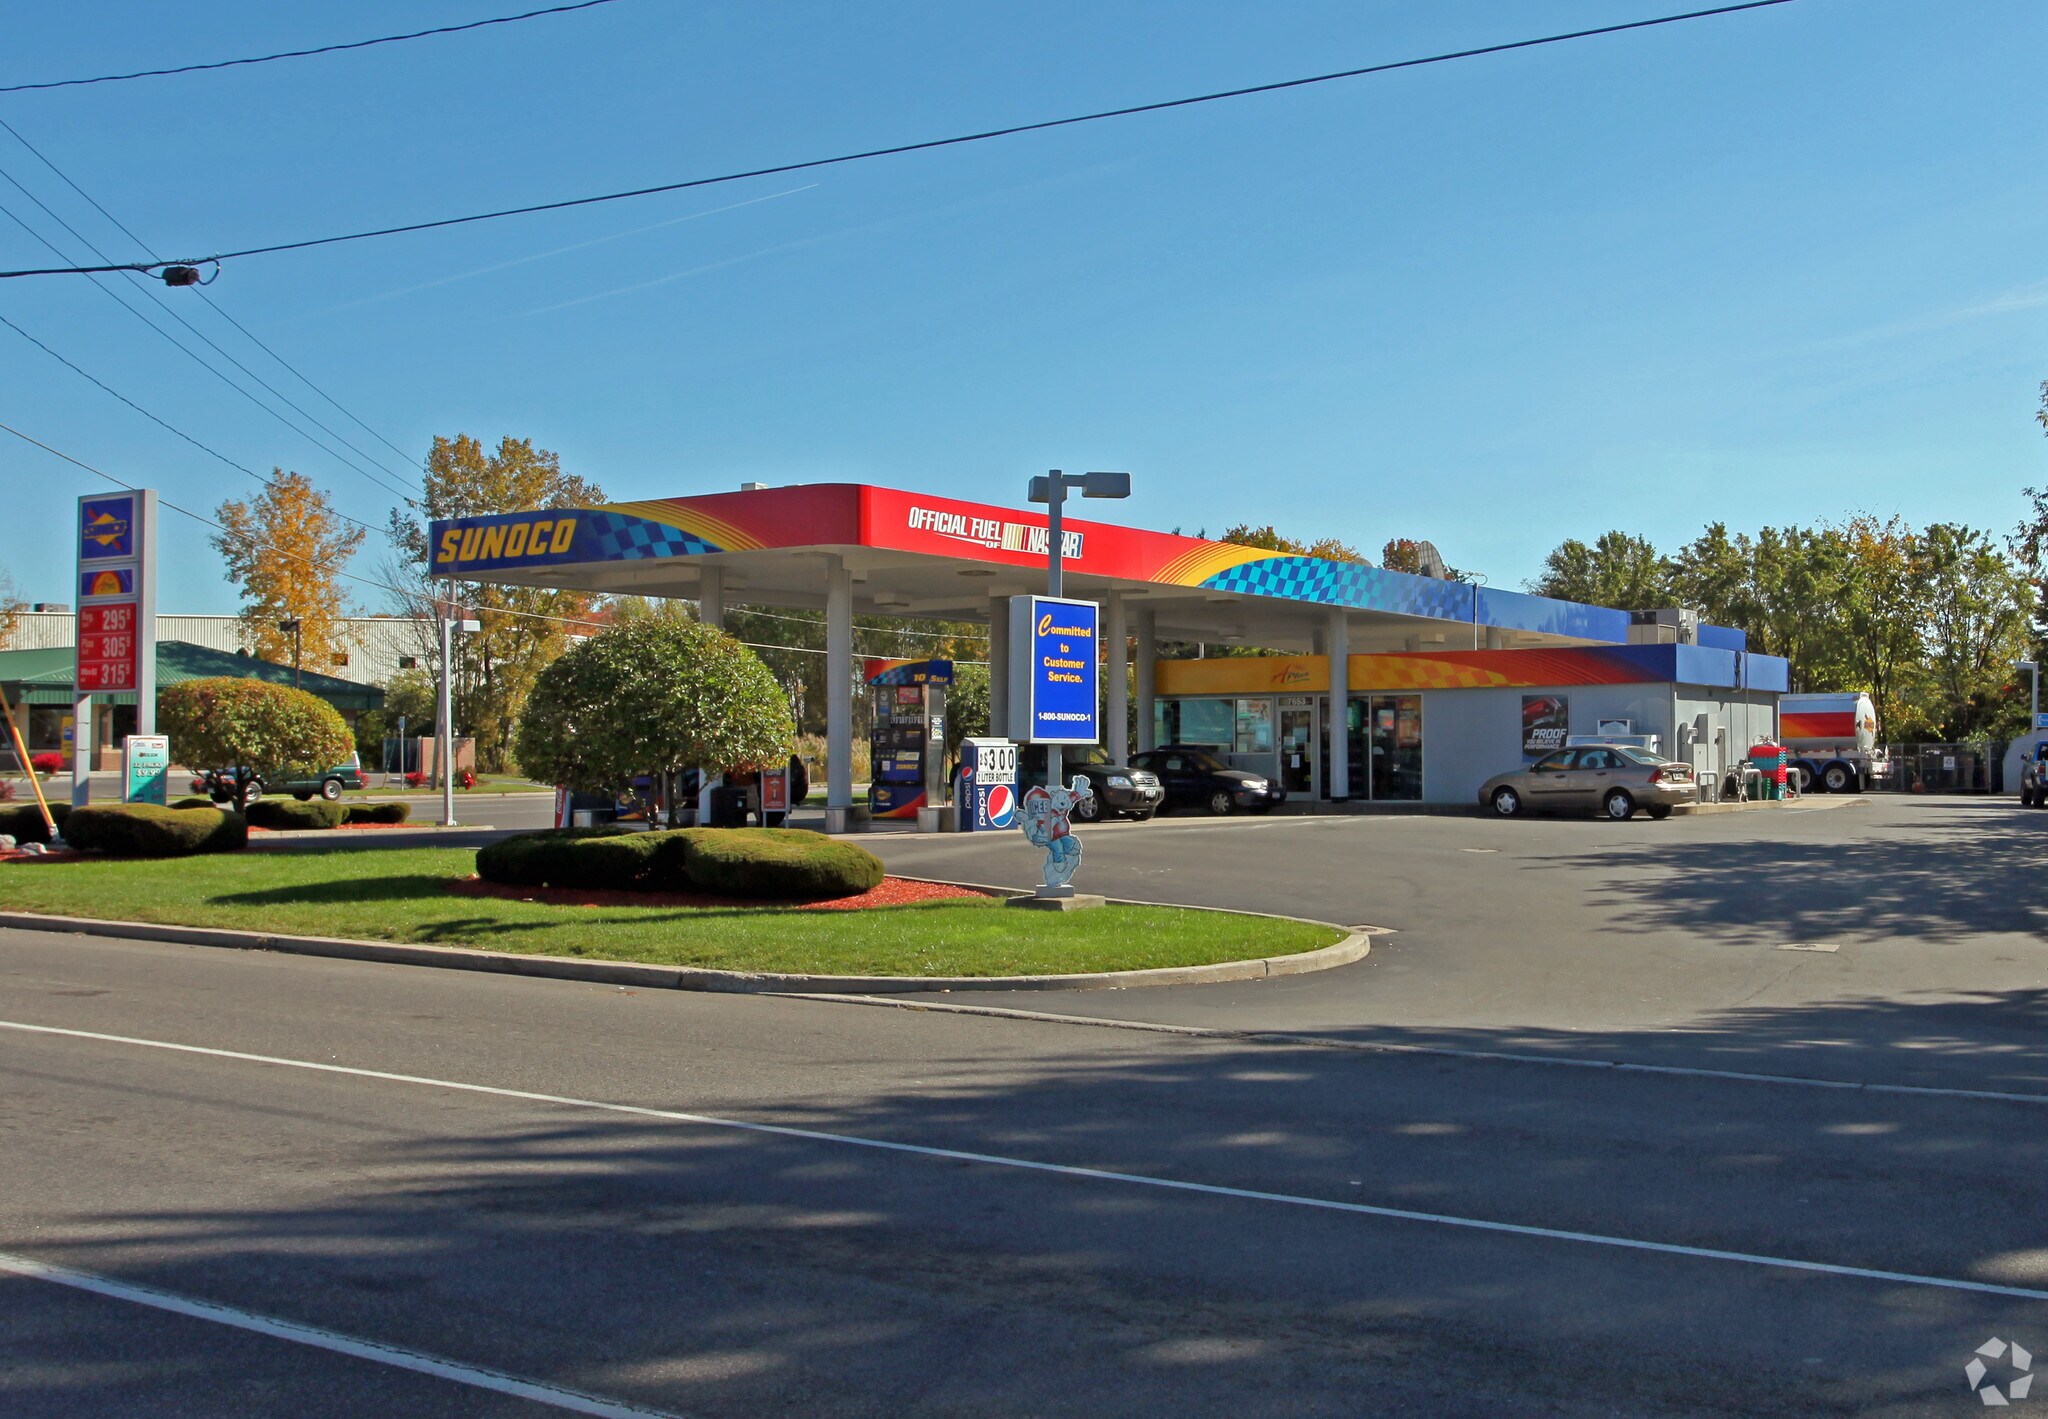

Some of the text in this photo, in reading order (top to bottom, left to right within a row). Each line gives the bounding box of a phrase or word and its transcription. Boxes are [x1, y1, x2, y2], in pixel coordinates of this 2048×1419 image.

[908, 506, 1001, 541] OFFICIAL FUEL
[436, 518, 577, 564] SUNOCO
[985, 541, 1001, 549] OF
[1027, 526, 1081, 558] NAAR
[1038, 614, 1091, 637] Committed
[1060, 643, 1069, 653] to
[1043, 656, 1085, 669] Customer
[914, 673, 926, 682] 10
[1048, 671, 1083, 683] Service.
[1288, 697, 1306, 705] 7653
[1038, 712, 1091, 722] 1-800-SUNOCO-1
[1532, 729, 1567, 739] PROOF
[981, 773, 994, 782] LITER
[995, 772, 1013, 782] BOTTLE
[964, 782, 972, 809] pepsi
[978, 788, 987, 826] pepsi
